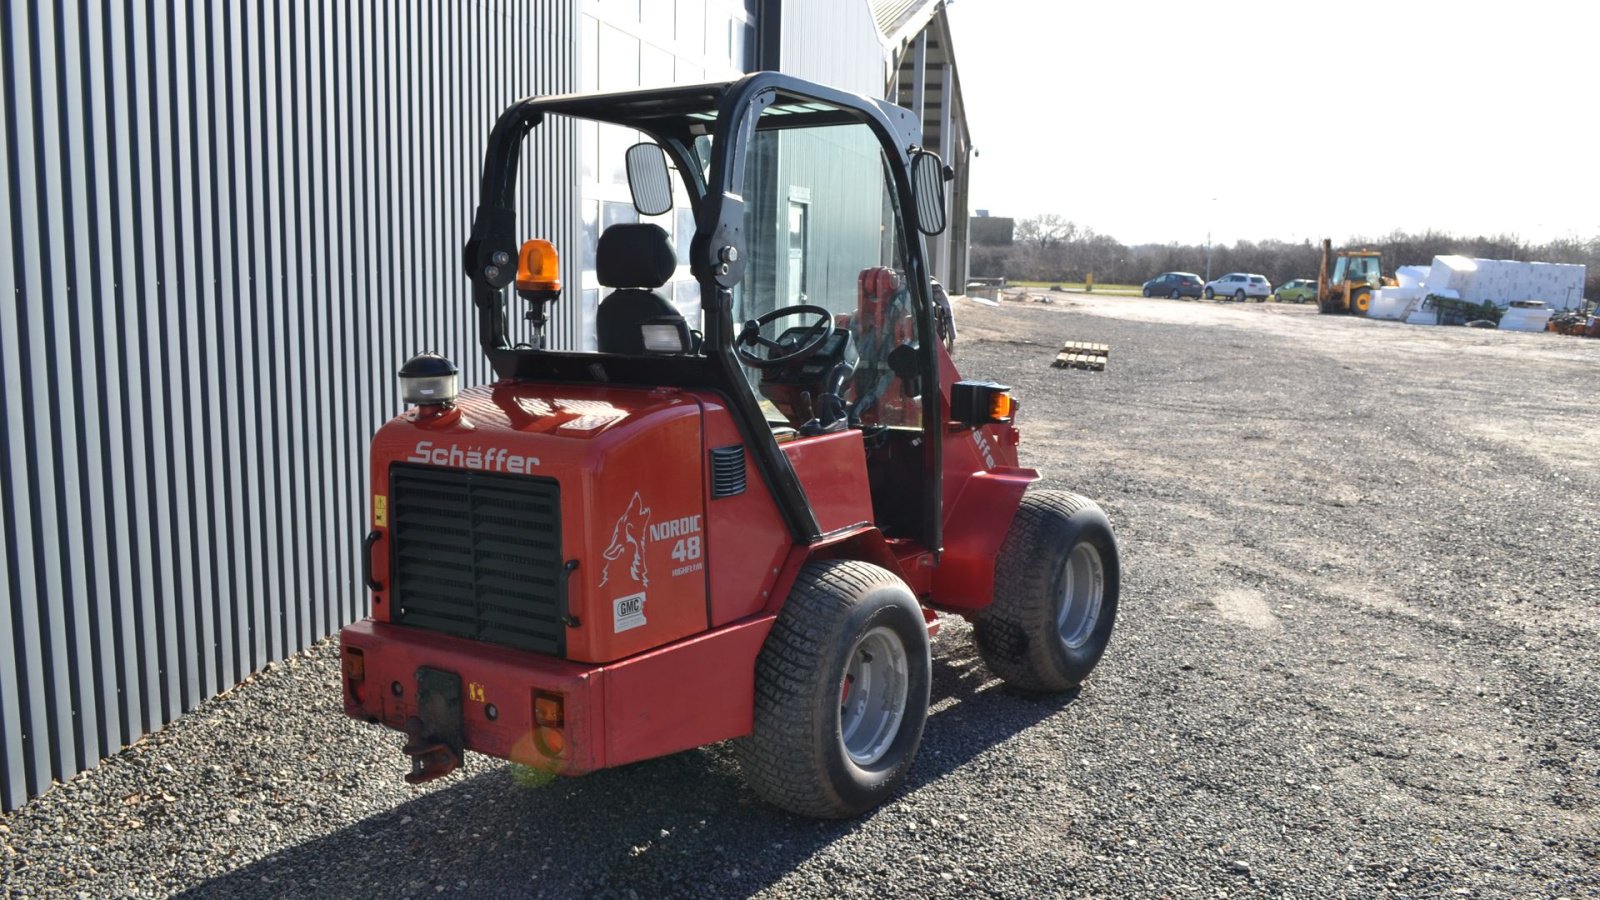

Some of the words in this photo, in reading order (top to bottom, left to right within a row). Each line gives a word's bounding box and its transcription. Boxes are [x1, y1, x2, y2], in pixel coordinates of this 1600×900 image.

[407, 440, 541, 475] Schäffer
[649, 514, 701, 542] NORDIC
[671, 535, 701, 563] 48
[620, 598, 640, 616] GMC
